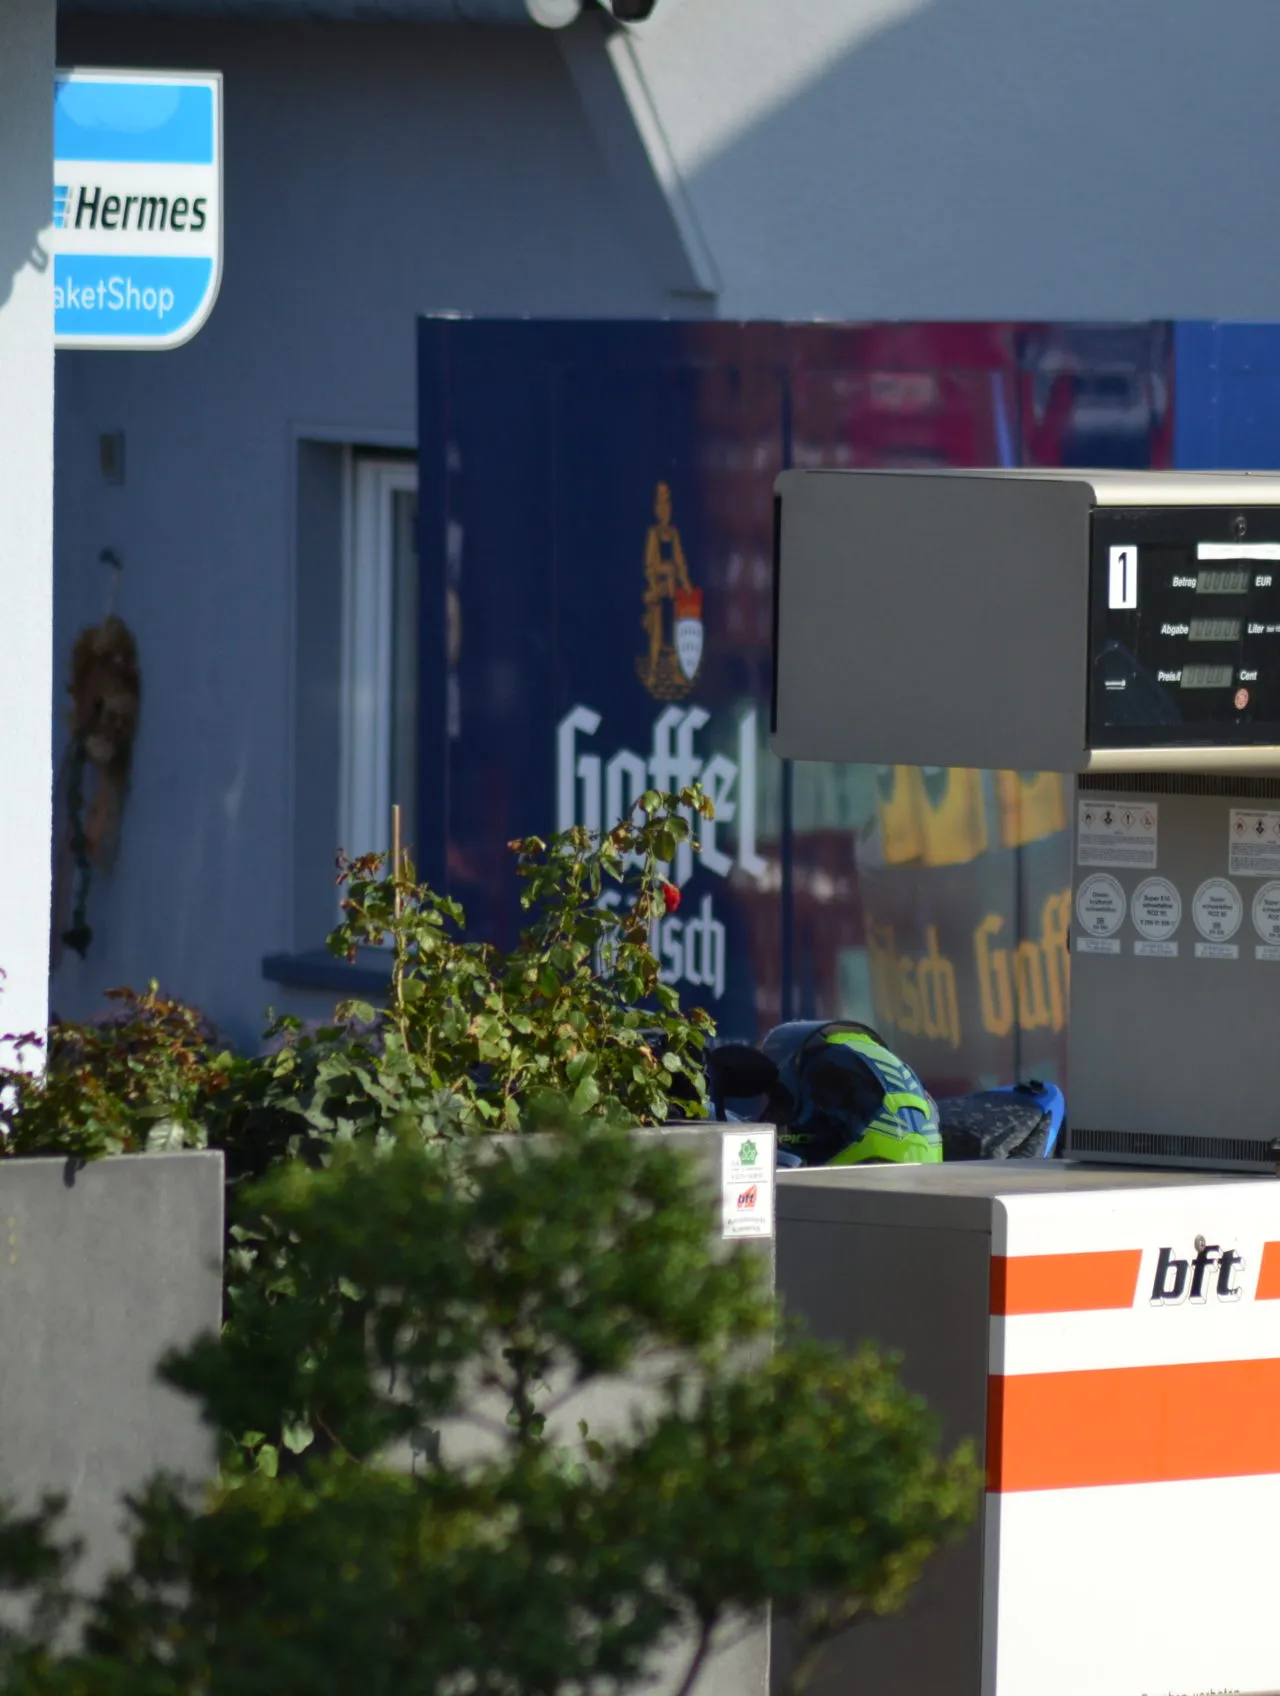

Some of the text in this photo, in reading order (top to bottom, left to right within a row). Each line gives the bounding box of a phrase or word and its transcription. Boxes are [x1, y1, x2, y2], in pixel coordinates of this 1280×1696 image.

[74, 185, 207, 233] Hermes
[1117, 551, 1128, 603] 1
[1172, 576, 1197, 590] Betrag
[1255, 576, 1272, 588] EUR
[1160, 623, 1189, 636] Abgabe
[1247, 622, 1265, 635] Liter
[1239, 670, 1258, 682] Cent
[556, 703, 768, 890] Gaffel
[595, 888, 727, 1001] Klsch
[1150, 1244, 1247, 1307] bft
